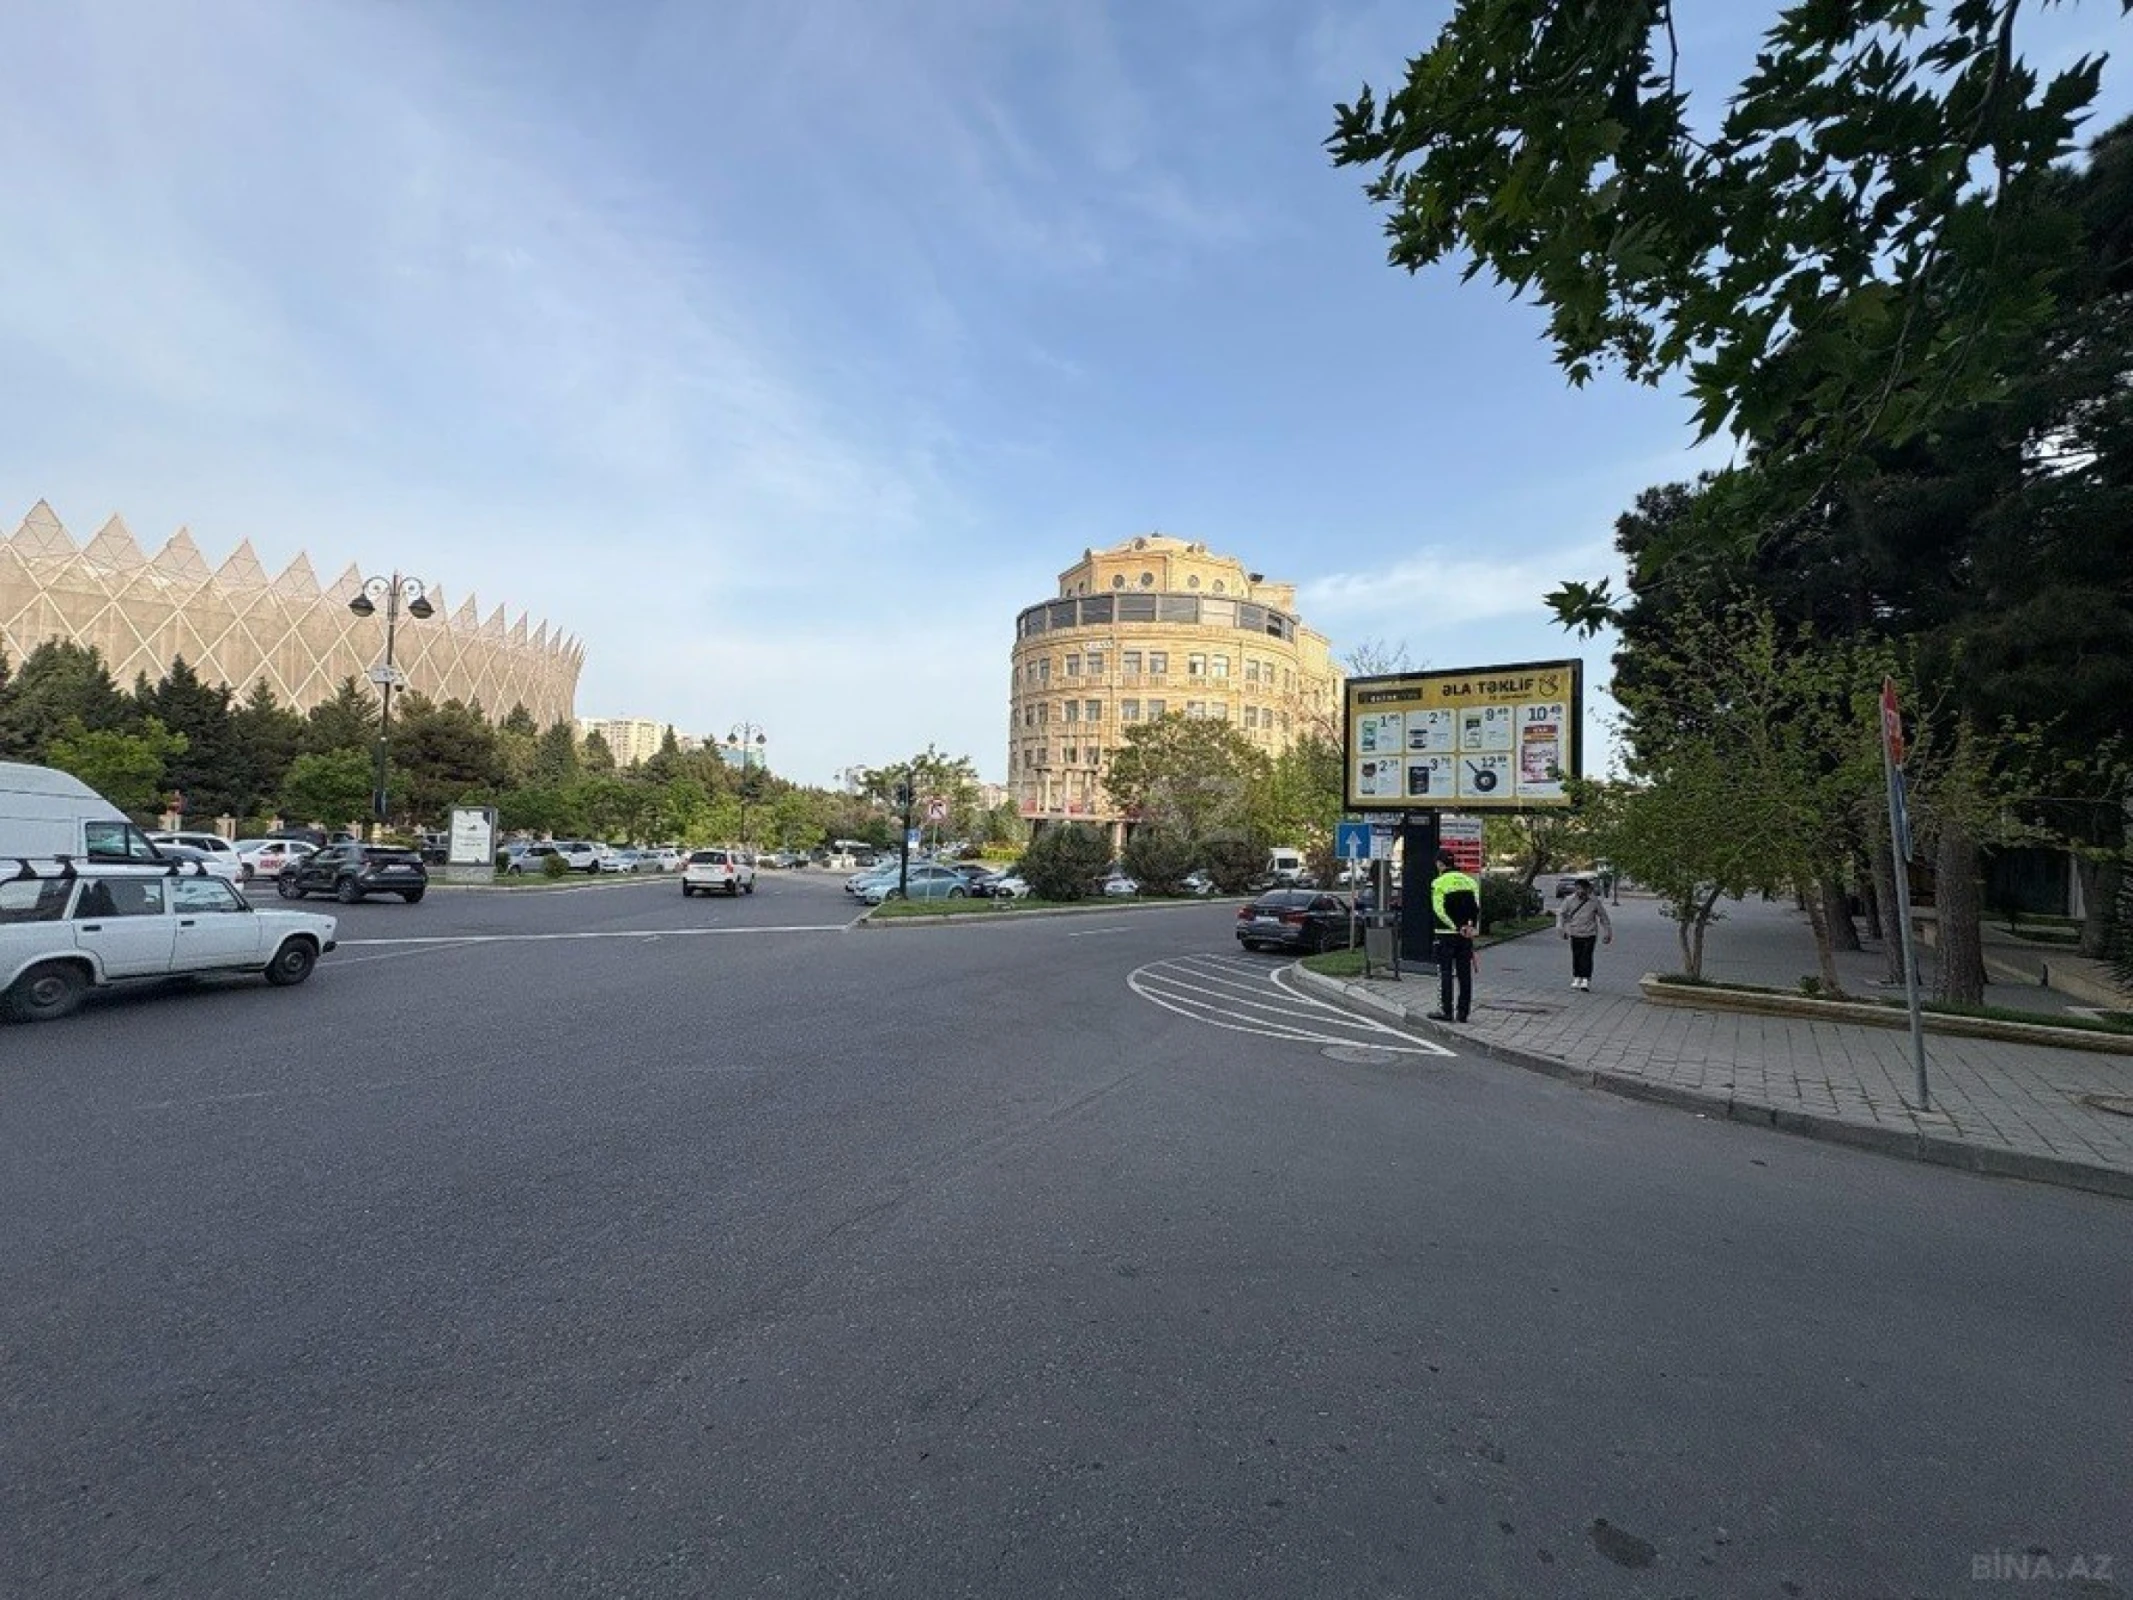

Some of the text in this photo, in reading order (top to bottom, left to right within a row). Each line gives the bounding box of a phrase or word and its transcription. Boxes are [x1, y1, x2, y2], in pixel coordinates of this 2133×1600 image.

[1428, 712, 1438, 724] 2
[1485, 708, 1495, 721] 9
[1528, 706, 1548, 721] 10
[1380, 715, 1388, 727] 1
[1379, 760, 1388, 772] 2
[1430, 758, 1438, 771] 3
[1481, 756, 1496, 768] 12
